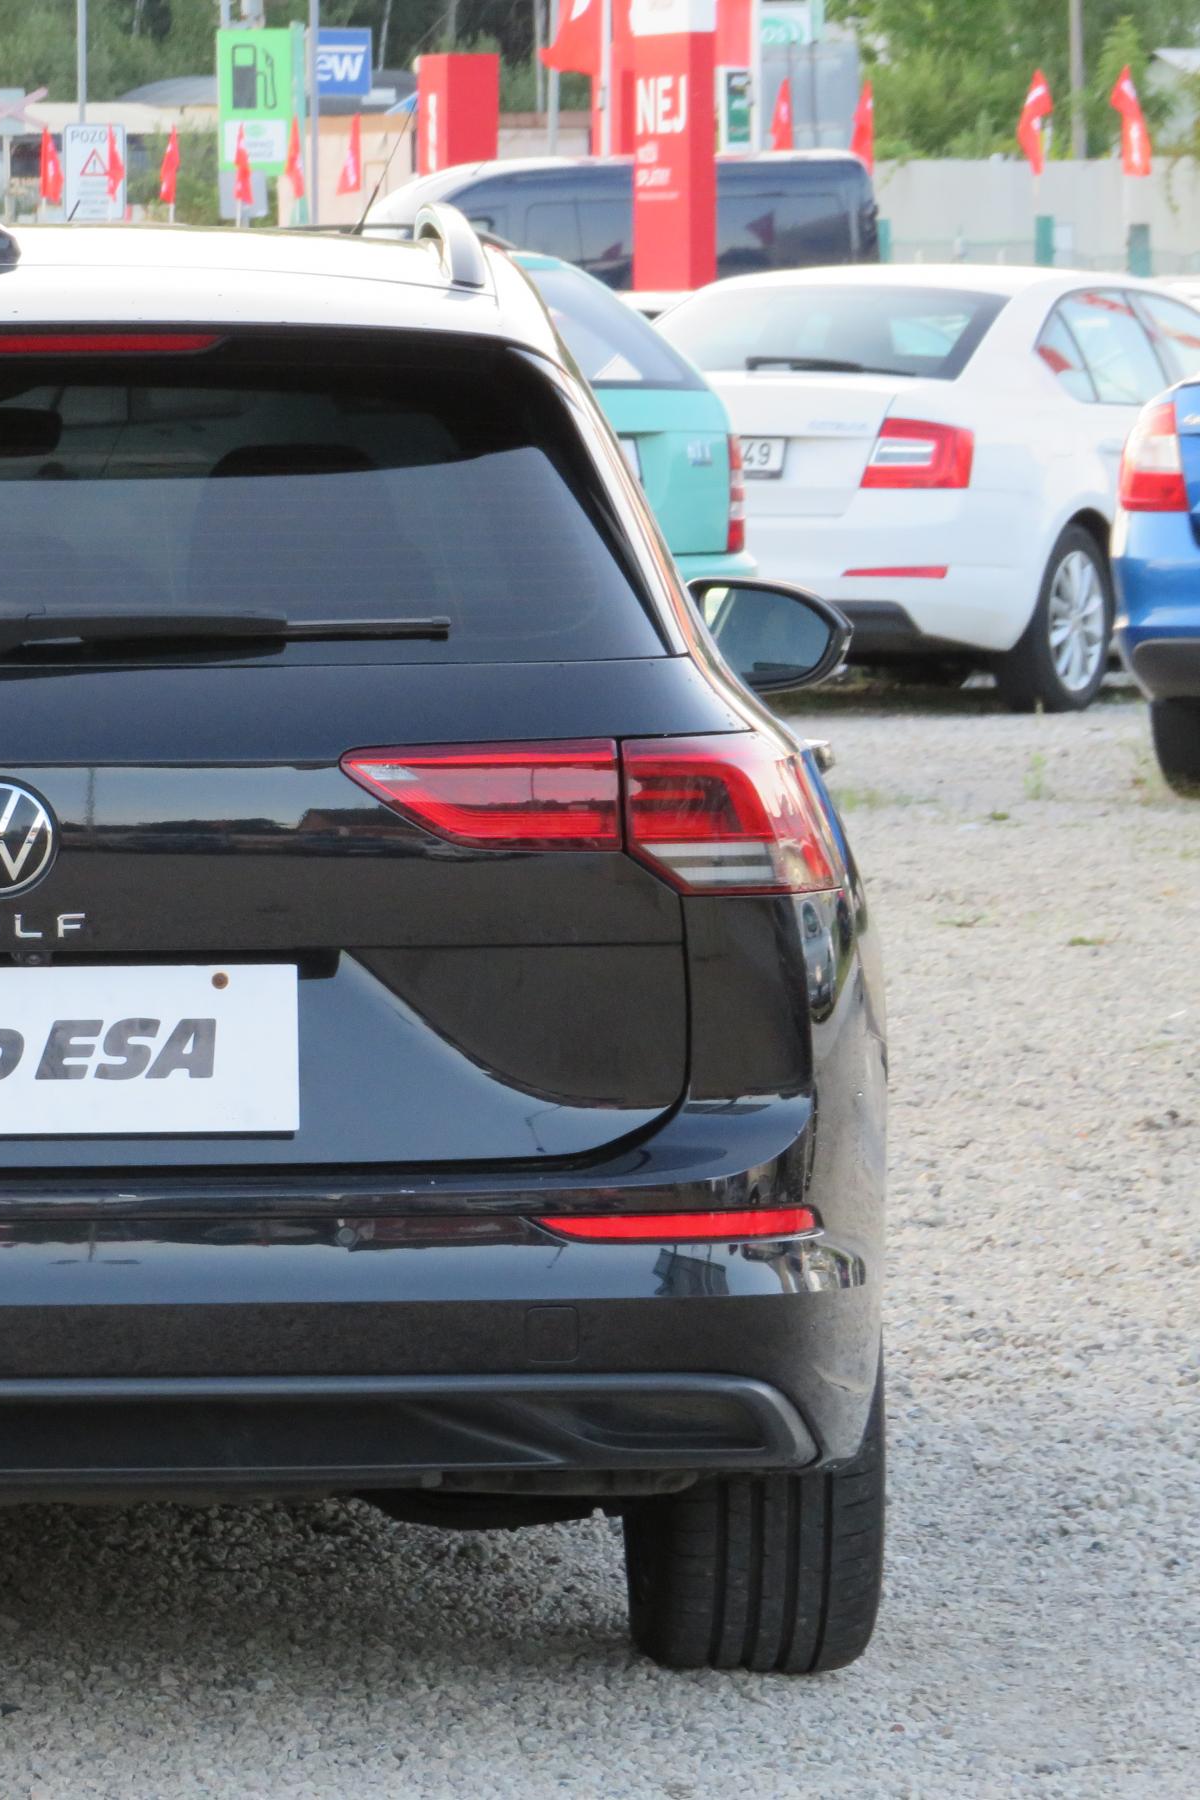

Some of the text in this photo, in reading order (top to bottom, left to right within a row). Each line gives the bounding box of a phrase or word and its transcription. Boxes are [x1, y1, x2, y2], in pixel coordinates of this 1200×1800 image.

[636, 74, 687, 135] NEJ
[70, 129, 110, 143] POZO
[34, 1017, 217, 1081] ESA
